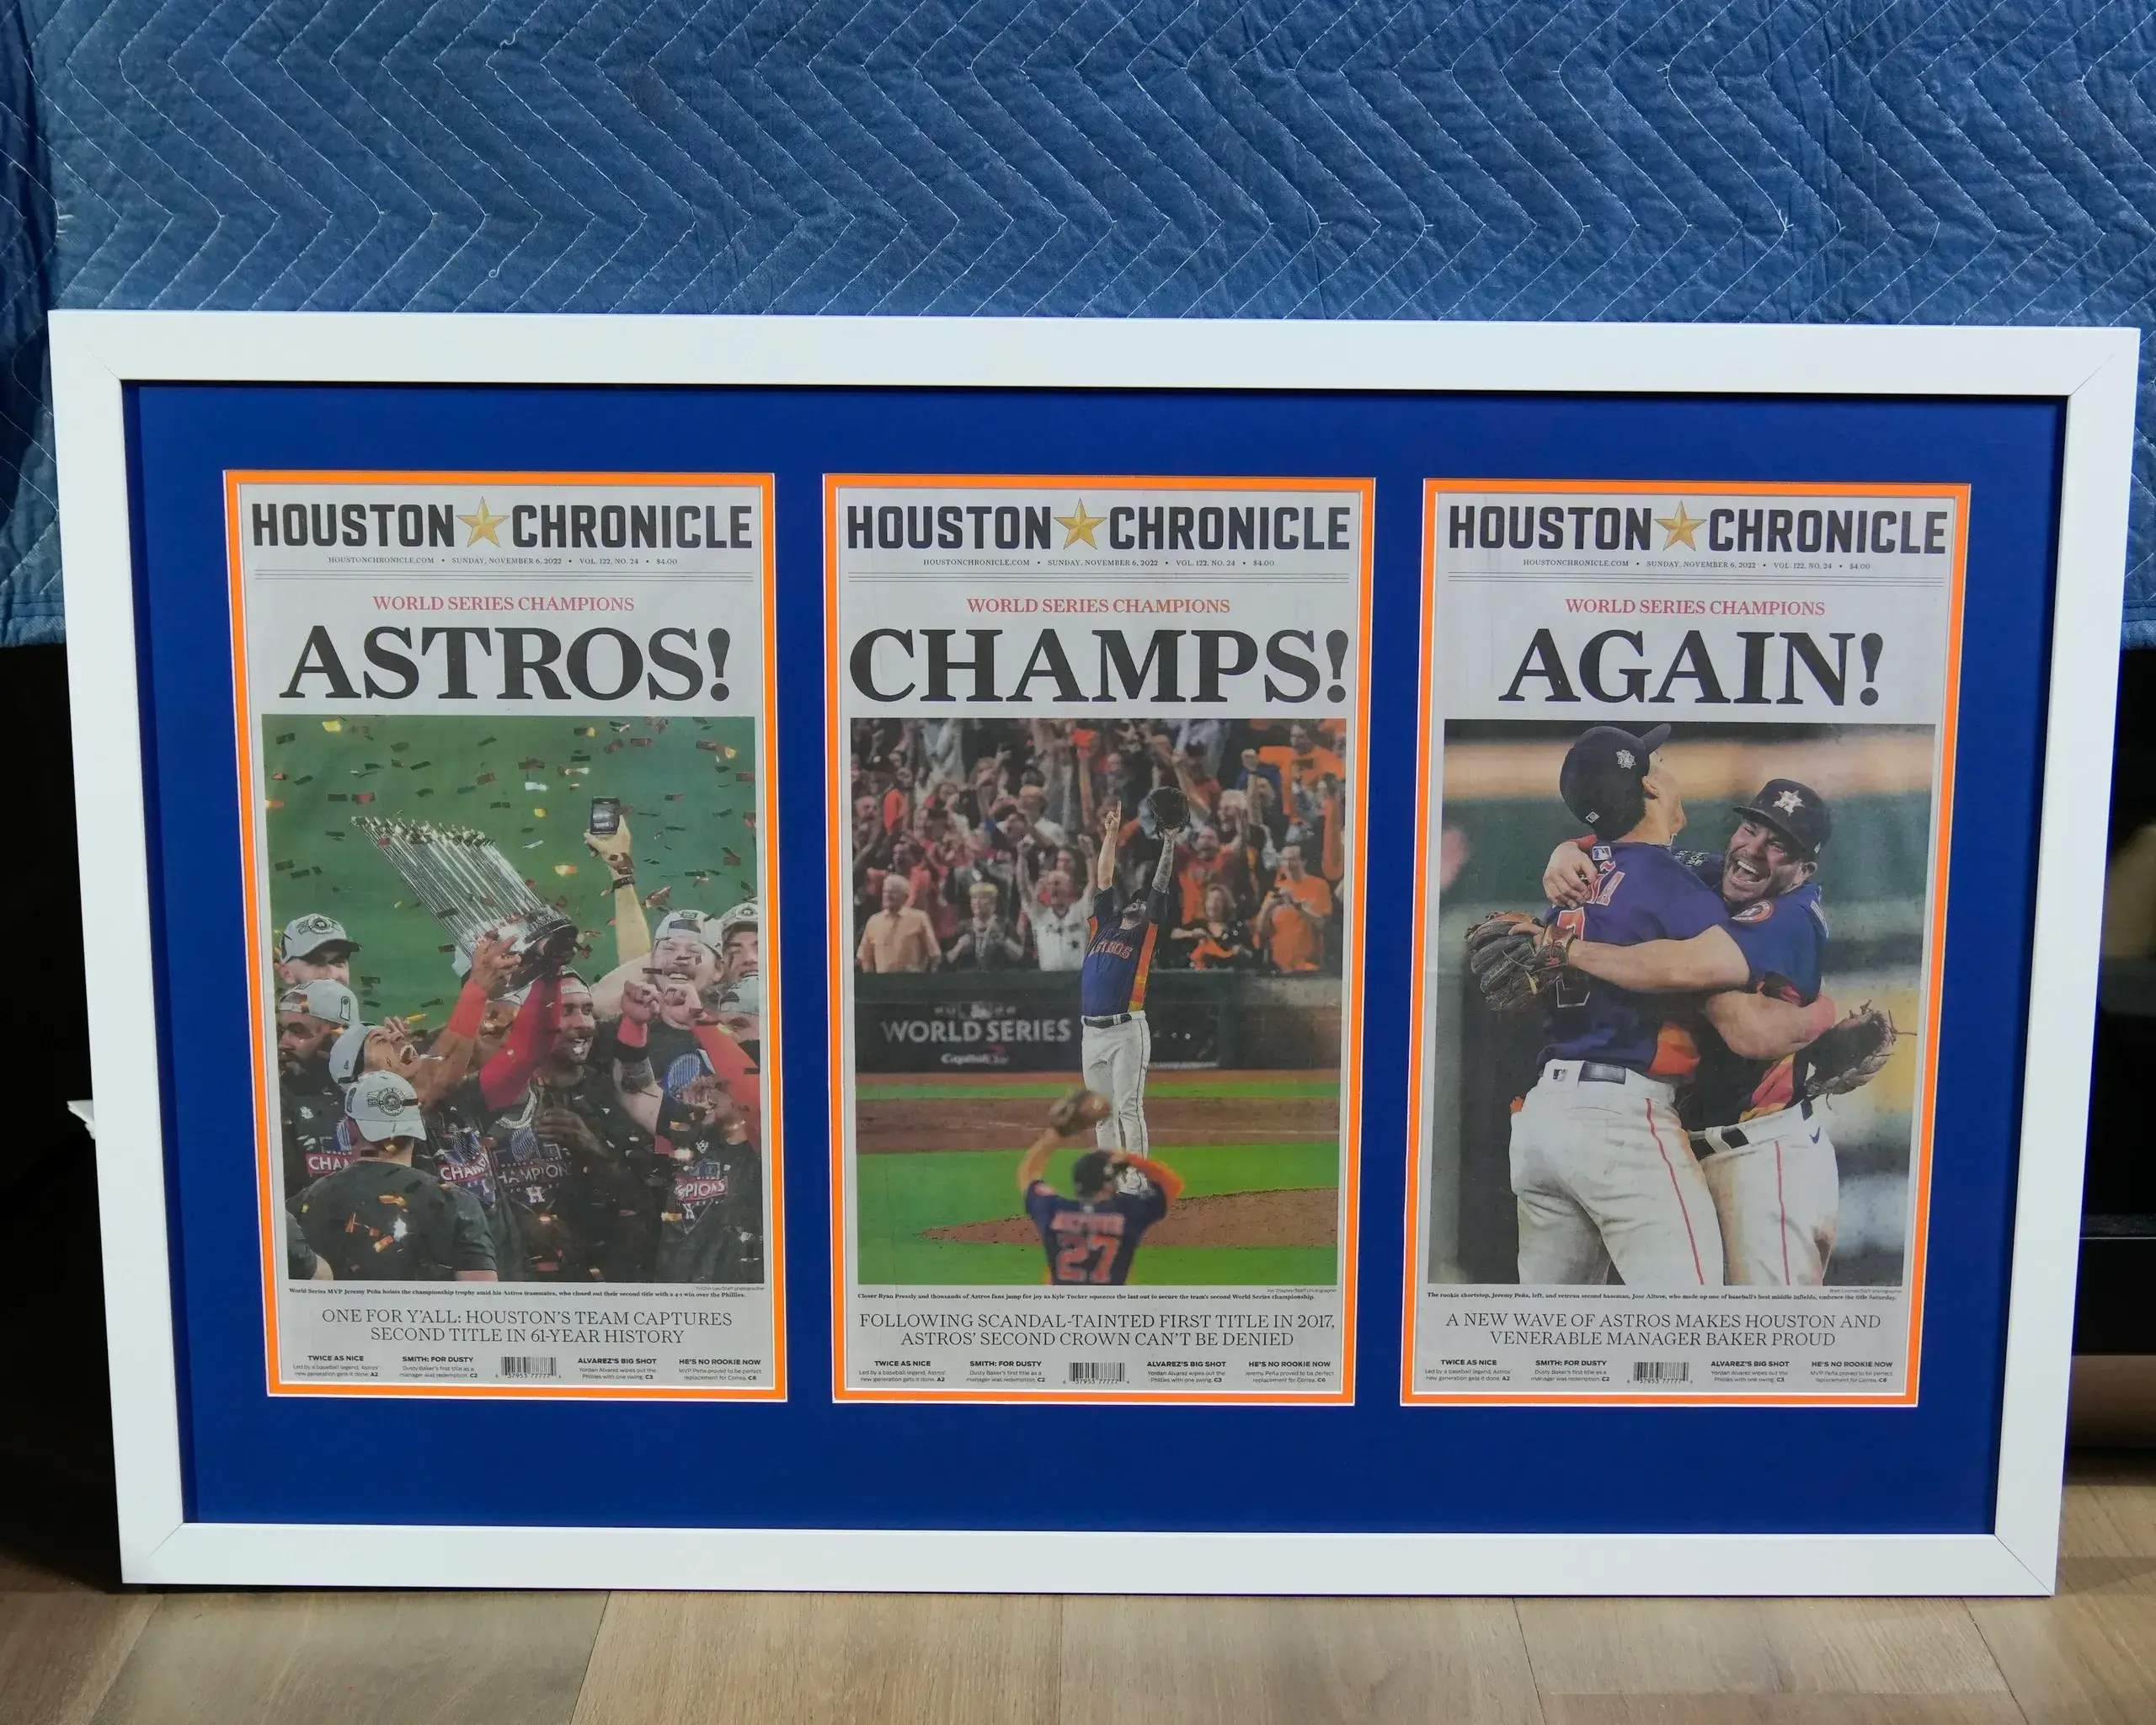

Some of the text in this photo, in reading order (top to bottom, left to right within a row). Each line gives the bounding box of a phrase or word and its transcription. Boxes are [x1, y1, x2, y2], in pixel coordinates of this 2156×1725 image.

[253, 503, 752, 549] HOUSTON CHRONICLE
[847, 506, 1349, 550] HOUSTON CHRONICLE
[1449, 505, 1948, 553] HOUSTON CHRONICLE
[328, 556, 435, 565] HOUSTONCHRONICLE.COM
[488, 557, 535, 565] NOVEMBER
[544, 557, 563, 565] 2022
[655, 557, 678, 566] $4.00
[922, 558, 1030, 567] HOUSTONCHRONICLE.COM
[1085, 558, 1131, 567] NOVEMBER
[1140, 558, 1159, 567] 2022
[1252, 558, 1276, 567] $4.00
[1523, 558, 1629, 567] HOUSTONCHRONICLE.COM
[1682, 560, 1729, 570] NOVEMBER
[1737, 561, 1756, 570] 2022
[1849, 562, 1871, 570] $4.00
[373, 596, 634, 612] WORLD SERIES CHAMPIONS
[966, 598, 1230, 613] WORLD SERIES CHAMPIONS
[1565, 598, 1824, 615] WORLD SERIES CHAMPIONS
[279, 625, 731, 702] ASTROS!
[849, 628, 1349, 702] CHAMPS!
[1498, 628, 1884, 706] AGAIN!
[881, 1018, 1072, 1044] WORLD SERIES
[322, 1309, 732, 1326] ONE FOR Y'ALL: HOUSTON'S TEAM CAPTURES
[859, 1313, 1334, 1328] FOLLOWING SCANDAL-TAINTED FIRST TITLE IN 2017,
[1445, 1312, 1880, 1327] A NEW WAVE OF ASTROS MAKES HOUSTON AND
[371, 1327, 684, 1343] SECOND TITLE IN 61-YEAR HISTORY
[900, 1332, 1293, 1345] ASTROS' SECOND CROWN CAN'T BE DENIED
[1490, 1331, 1834, 1345] VENERABLE MANAGER BAKER PROUD
